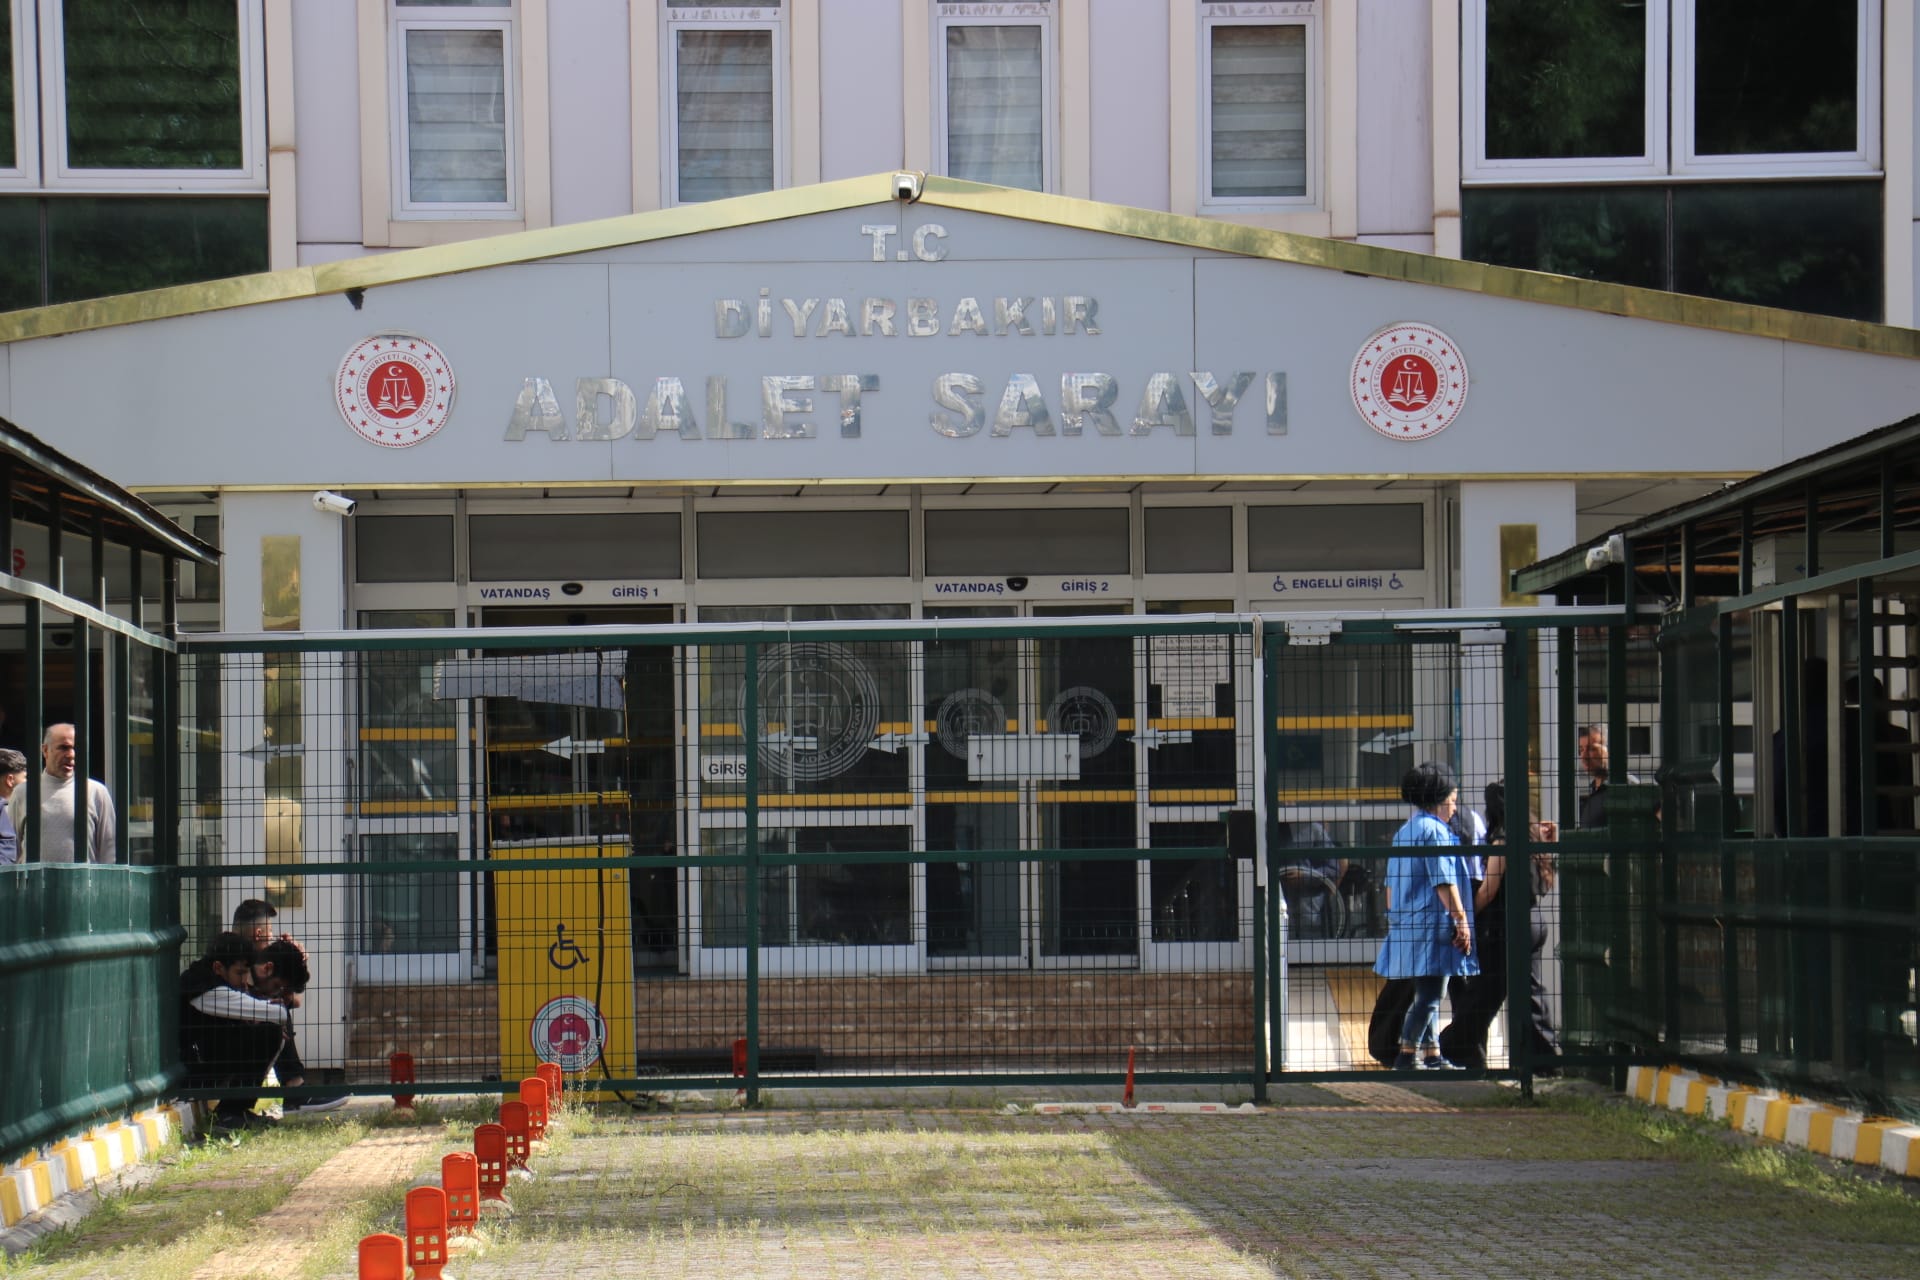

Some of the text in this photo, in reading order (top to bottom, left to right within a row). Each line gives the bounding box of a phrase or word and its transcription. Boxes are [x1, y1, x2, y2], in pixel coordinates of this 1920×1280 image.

[861, 224, 949, 262] T.C
[714, 287, 1103, 339] DİYARBAKIR
[504, 372, 1288, 441] ADALET SARAYI
[935, 579, 1109, 595] VATANDAŞ GİRİŞ 2
[1292, 575, 1383, 590] ENGELLİ GİRİŞİ
[480, 585, 659, 600] VATANDAŞ GİRİŞ 1
[708, 760, 747, 777] GİRİŞ
